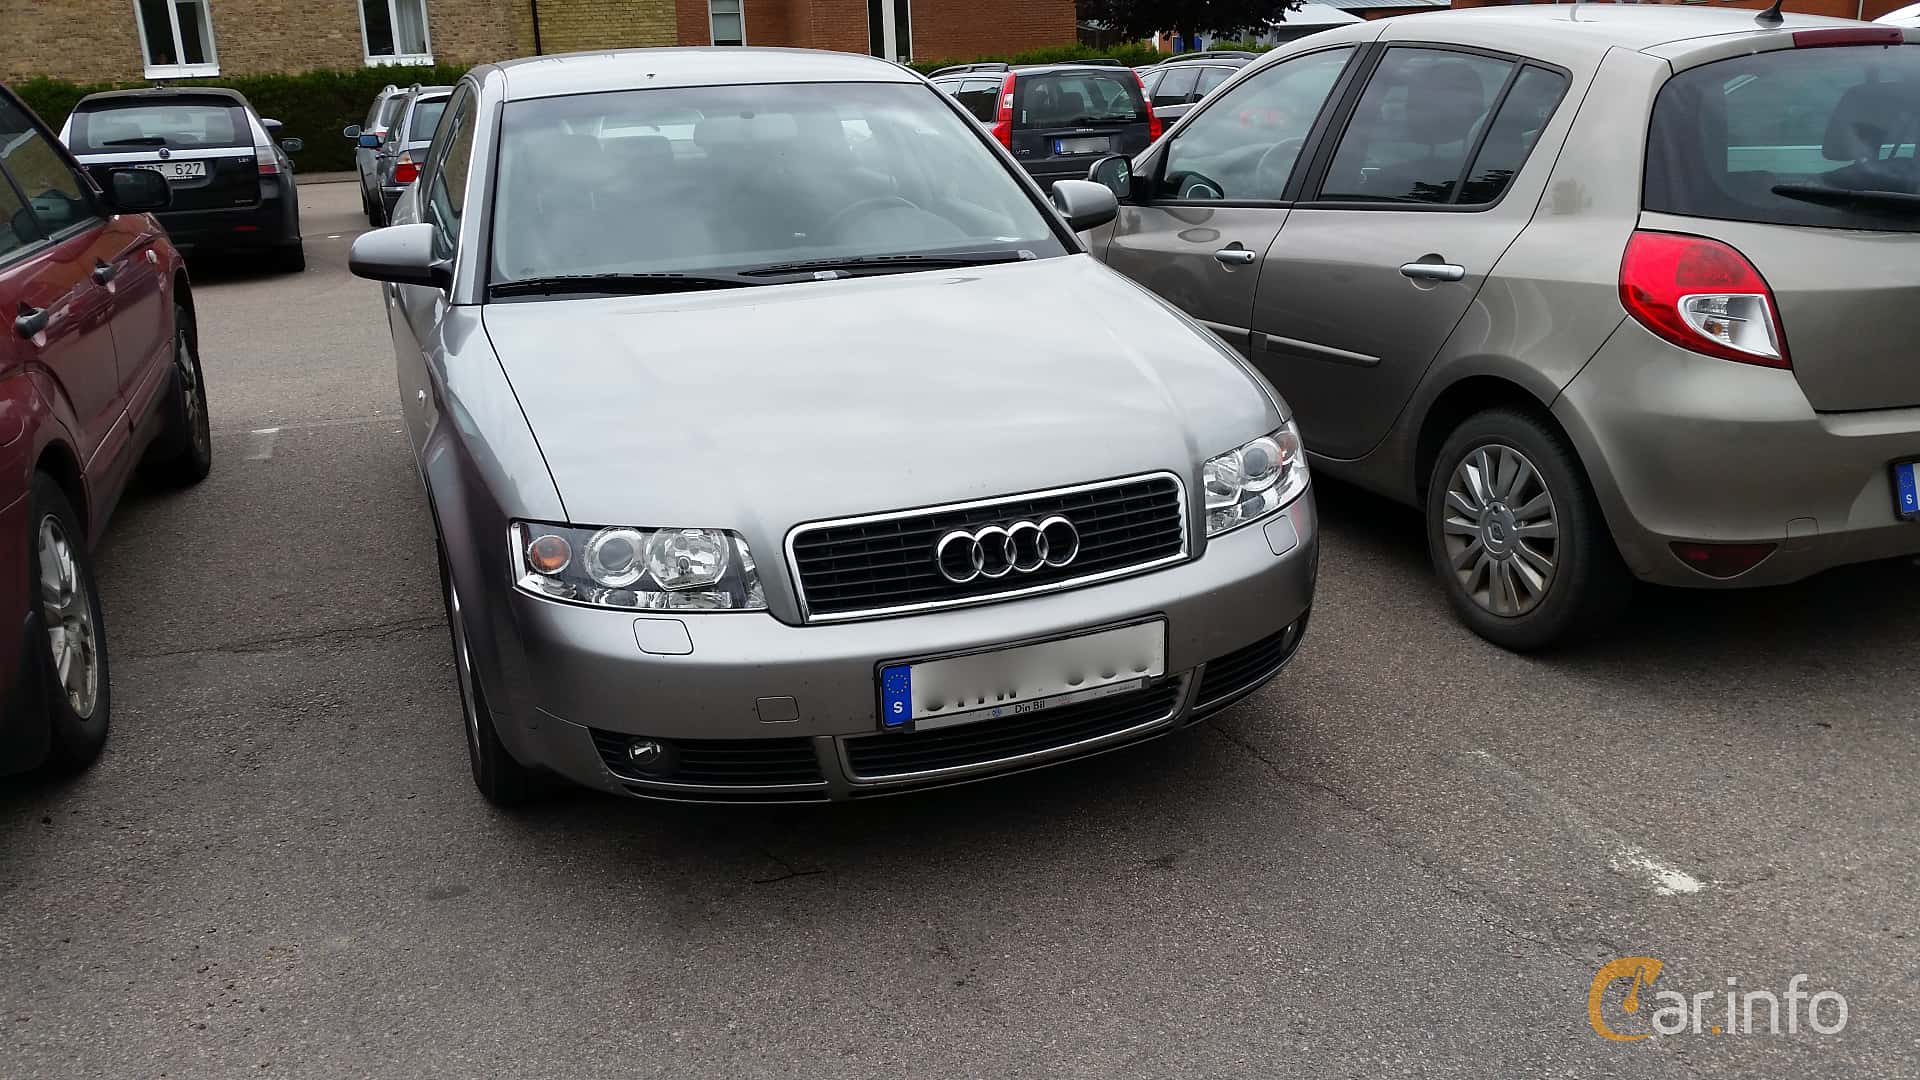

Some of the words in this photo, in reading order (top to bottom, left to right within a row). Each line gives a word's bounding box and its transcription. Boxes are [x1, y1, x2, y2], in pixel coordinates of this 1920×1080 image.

[175, 162, 201, 175] 627
[1906, 494, 1913, 504] S
[893, 701, 903, 713] S
[1015, 703, 1030, 713] Din
[1033, 699, 1045, 710] Bil
